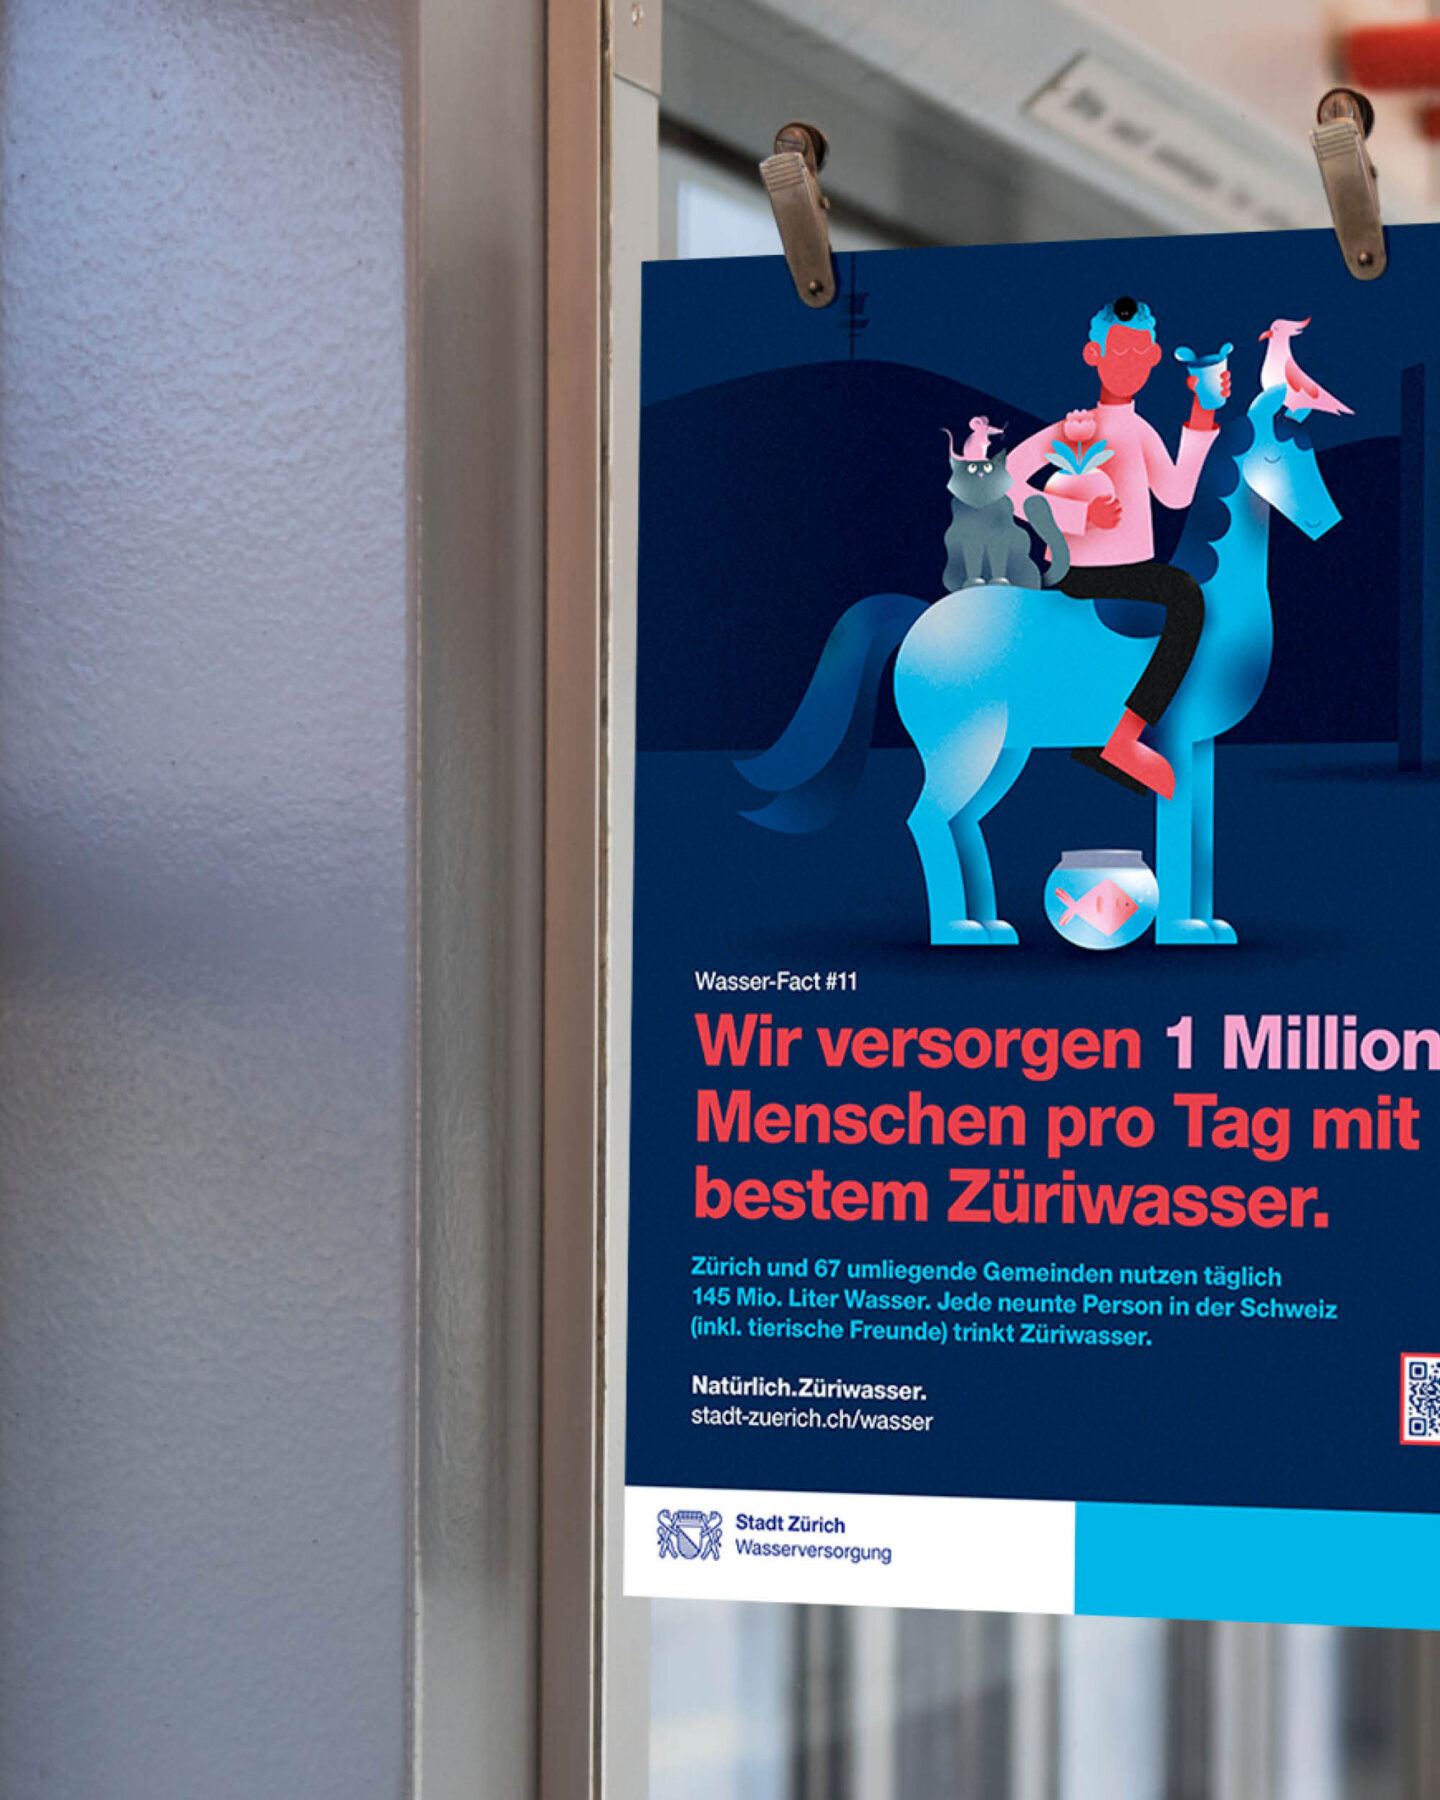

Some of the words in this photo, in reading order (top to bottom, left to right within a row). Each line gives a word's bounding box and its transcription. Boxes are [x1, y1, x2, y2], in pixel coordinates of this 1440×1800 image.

[694, 970, 821, 992] Wasser-Fact
[825, 971, 857, 991] #11
[693, 1012, 803, 1067] Wir
[815, 1026, 1142, 1082] versorgen
[1165, 1015, 1193, 1070] 1
[696, 1088, 1026, 1147] Menschen
[1047, 1104, 1156, 1160] pro
[1172, 1092, 1291, 1163] Tag
[1312, 1093, 1421, 1151] mit
[694, 1164, 929, 1223] bestem
[946, 1167, 1329, 1229] Züriwasser.
[691, 1255, 761, 1277] Zürich
[767, 1257, 808, 1278] und
[814, 1258, 841, 1278] 67
[847, 1259, 978, 1284] umliegende
[983, 1261, 1113, 1284] Gemeinden
[1119, 1265, 1198, 1286] nutzen
[1203, 1265, 1282, 1291] täglich
[692, 1286, 731, 1306] 145
[736, 1286, 783, 1307] Mio.
[789, 1287, 840, 1308] Liter
[843, 1288, 931, 1310] Wasser.
[936, 1291, 993, 1312] Jede
[998, 1294, 1077, 1314] neunte
[1083, 1293, 1163, 1316] Person
[1169, 1295, 1190, 1316] in
[1195, 1296, 1236, 1317] der
[1239, 1297, 1338, 1319] Schweiz
[690, 1315, 742, 1340] (inkl.
[747, 1317, 844, 1339] tierische
[850, 1319, 948, 1345] Freunde)
[952, 1321, 1015, 1343] trinkt
[1019, 1323, 1152, 1346] Züriwasser.
[691, 1374, 927, 1401] Natürlich.Züriwasser.
[690, 1405, 935, 1432] stadt-zuerich.ch/wasser
[735, 1512, 785, 1532] Stadt
[787, 1514, 846, 1534] Zürich
[735, 1538, 893, 1565] Wasserversorgung
